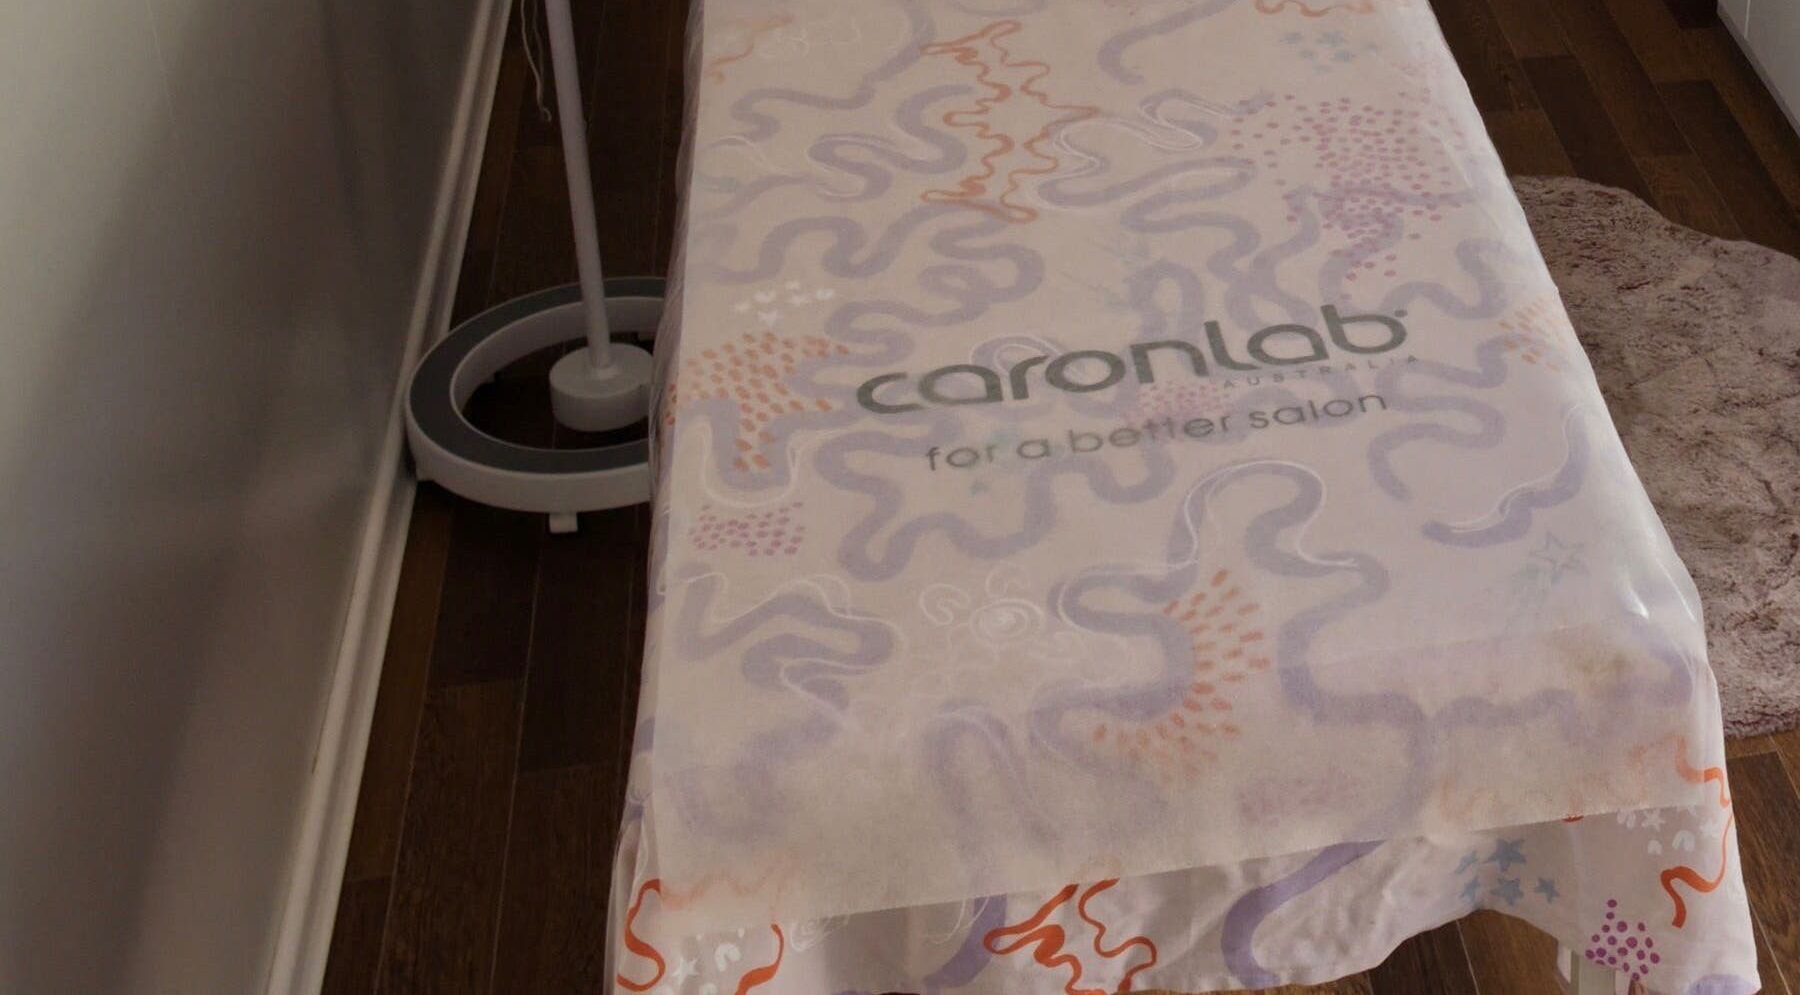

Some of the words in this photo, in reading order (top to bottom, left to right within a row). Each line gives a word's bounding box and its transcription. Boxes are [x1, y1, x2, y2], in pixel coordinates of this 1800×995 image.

[857, 305, 1408, 414] caronlab
[1223, 355, 1418, 390] AUSTRALIA
[925, 446, 997, 471] for
[1017, 439, 1050, 459] a
[1069, 413, 1230, 453] better
[1249, 394, 1387, 429] salon
